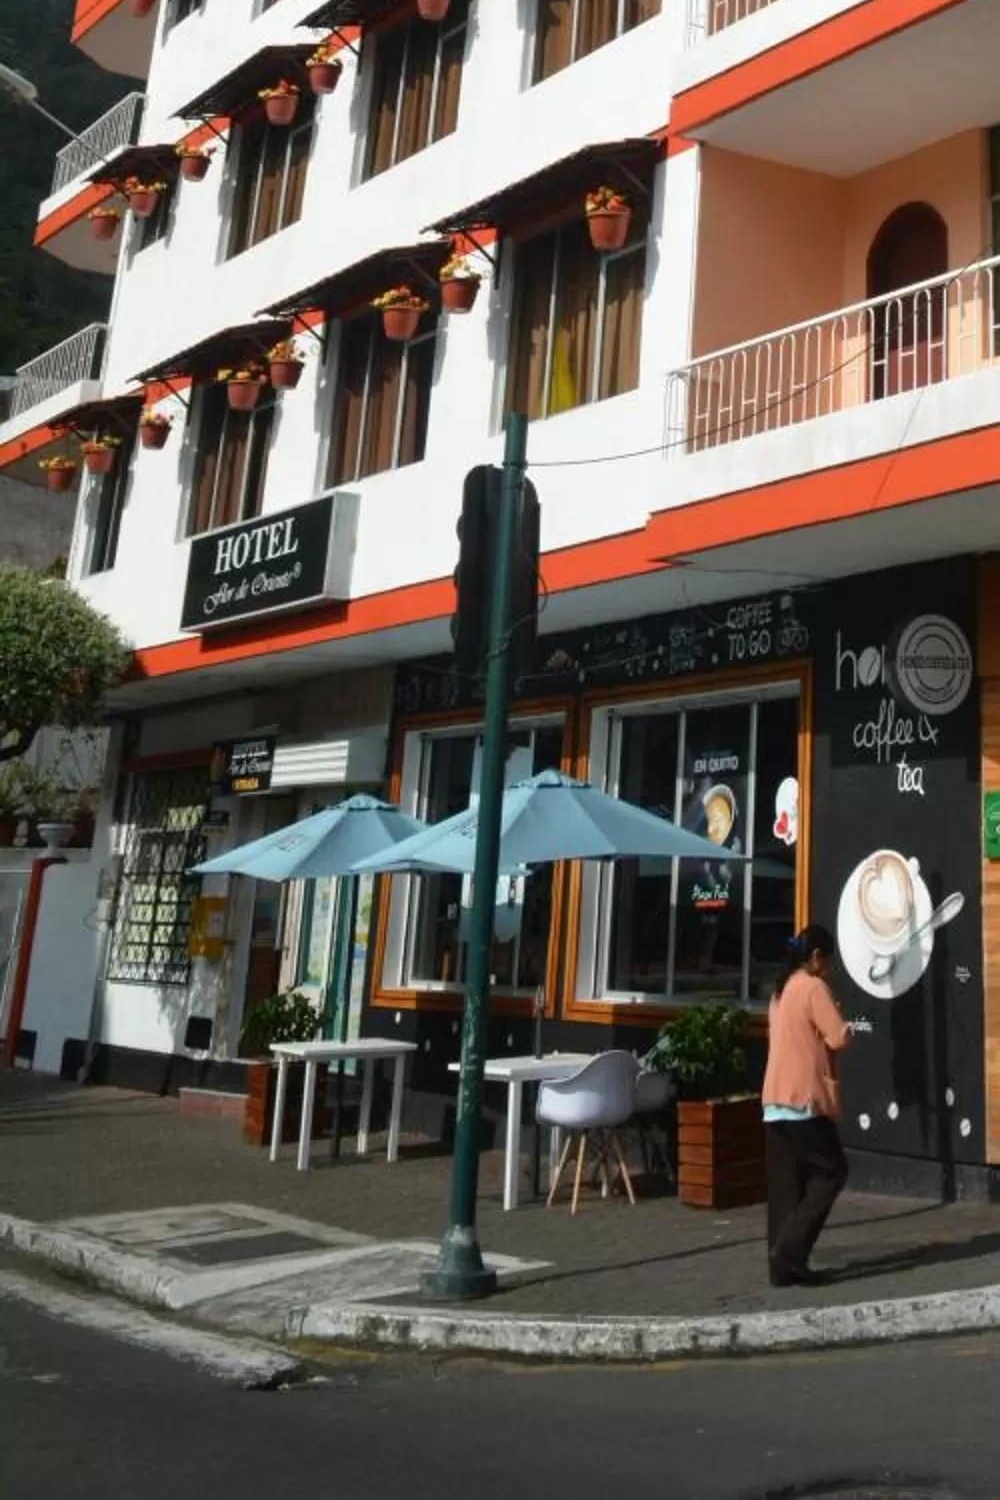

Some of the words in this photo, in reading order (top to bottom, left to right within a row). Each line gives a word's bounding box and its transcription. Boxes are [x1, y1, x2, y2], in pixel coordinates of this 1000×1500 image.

[213, 516, 299, 575] HOTEL
[727, 599, 772, 629] COFFEE
[728, 634, 745, 661] TO
[748, 629, 771, 659] GO
[853, 697, 915, 764] coffee
[896, 751, 925, 796] tea
